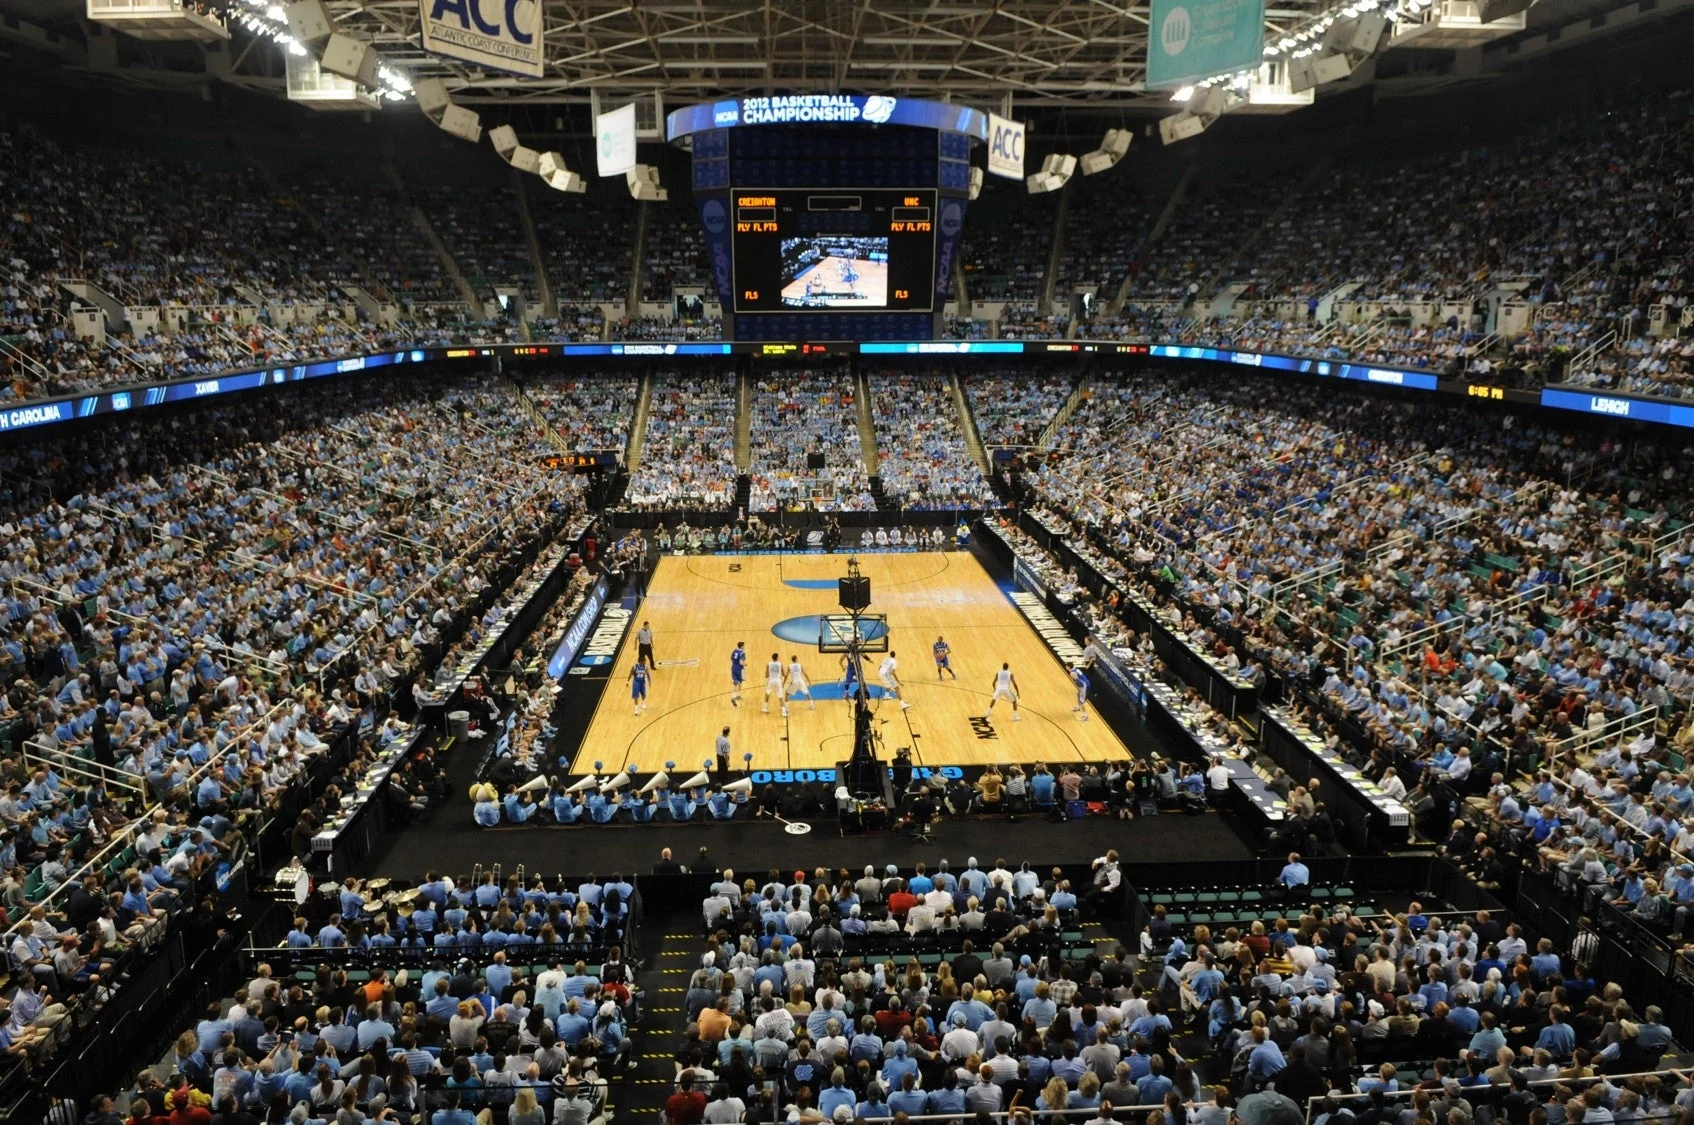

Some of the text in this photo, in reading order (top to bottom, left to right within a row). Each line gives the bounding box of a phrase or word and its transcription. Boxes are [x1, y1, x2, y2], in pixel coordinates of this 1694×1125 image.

[430, 0, 535, 44] ACC
[431, 26, 465, 44] ATLANTIC
[467, 35, 492, 51] COAST
[743, 95, 854, 109] 2012 BASKETBALL
[715, 110, 739, 123] NCAA
[743, 106, 861, 124] CHAMPIONSHIP
[992, 125, 1022, 161] ACC
[738, 197, 776, 206] CREIGHTON
[904, 197, 920, 206] UNC
[737, 223, 778, 232] PLY FL PTS
[891, 222, 931, 231] PLY FL PTS
[745, 291, 758, 299] FLS
[895, 290, 908, 299] FLS
[195, 381, 220, 395] XAVIER
[1468, 385, 1504, 400] 6:05 PM
[1591, 397, 1630, 415] LEHIGH
[11, 406, 61, 428] CAROLINA
[583, 617, 630, 655] BASKETBALL
[968, 716, 999, 740] NCAA
